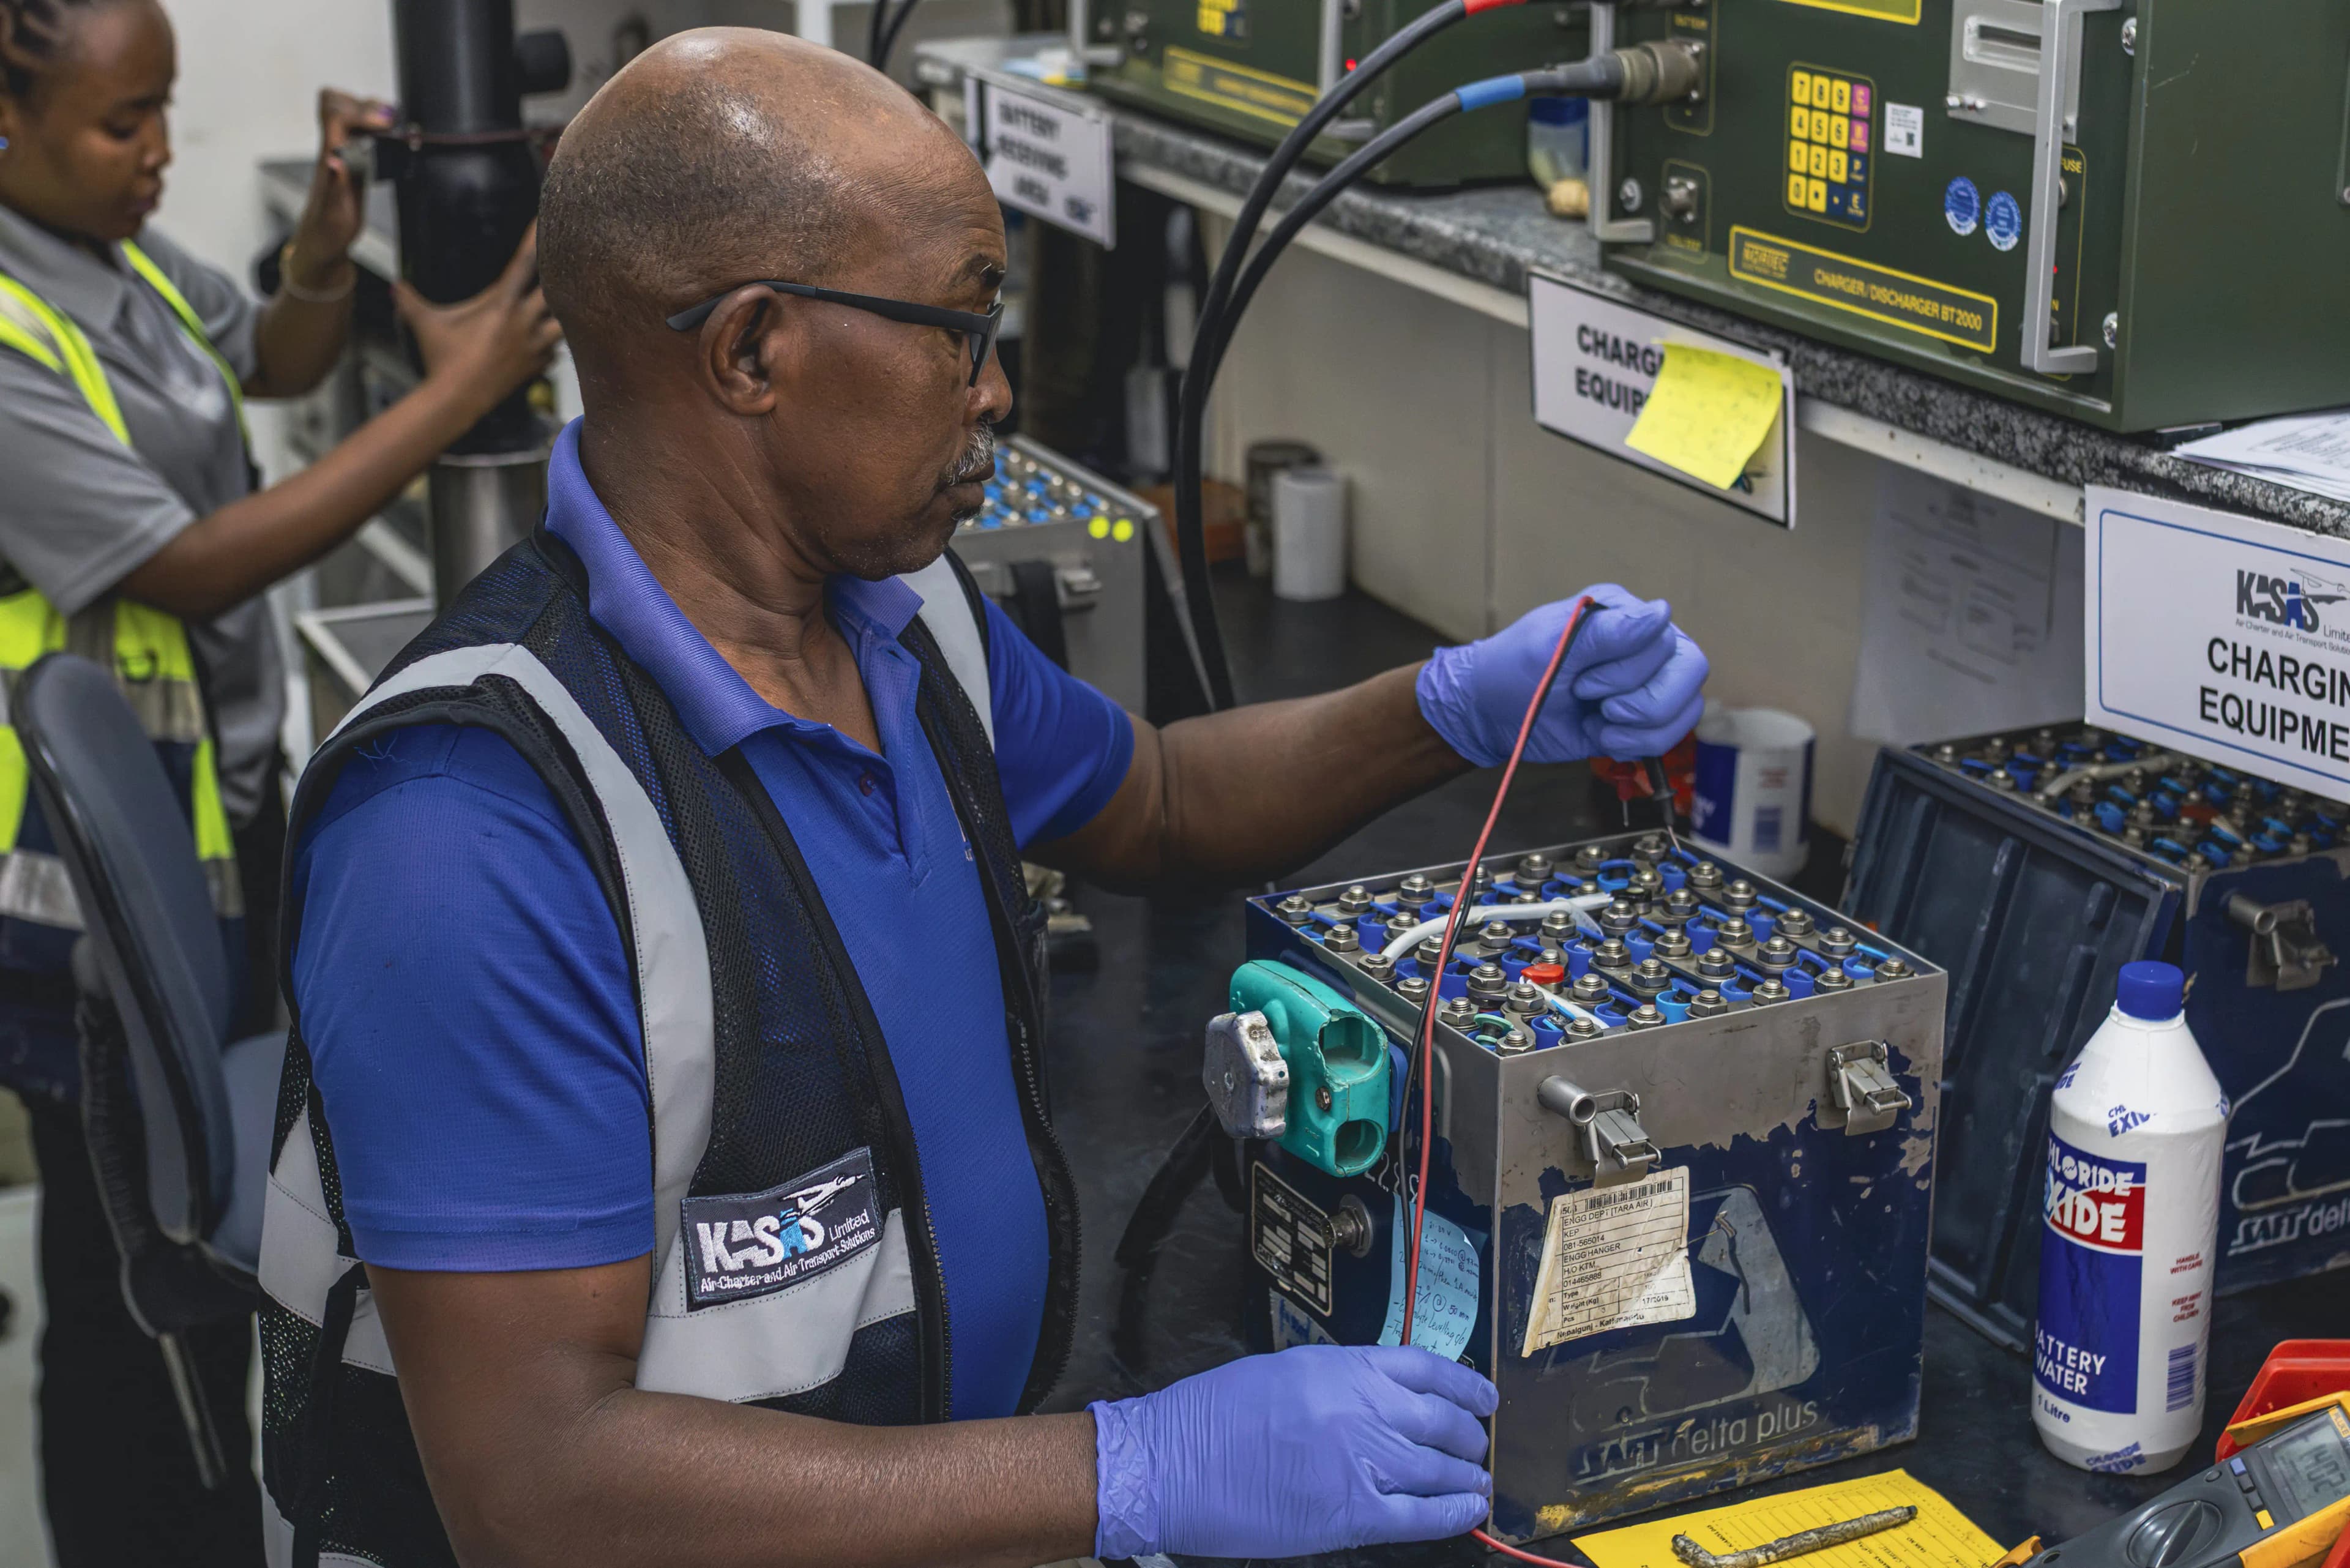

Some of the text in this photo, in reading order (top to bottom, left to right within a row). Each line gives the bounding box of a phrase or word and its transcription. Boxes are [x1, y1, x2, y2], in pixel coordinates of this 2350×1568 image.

[1798, 79, 1805, 98] 7
[1817, 84, 1825, 102] 8
[1837, 89, 1844, 106] 9
[1816, 118, 1824, 136] 5
[1835, 123, 1843, 141] 6
[1815, 153, 1822, 170] 2
[1833, 157, 1841, 175] 3
[1575, 366, 1651, 417] EQUIP
[2237, 569, 2319, 633] KASAS
[2271, 629, 2283, 638] and
[2285, 630, 2294, 641] Air
[2296, 633, 2327, 650] Transport
[2200, 685, 2350, 764] EQUIPME
[1564, 1213, 1587, 1226] ENGG
[1589, 1209, 1608, 1221] DEPT
[1636, 1200, 1649, 1209] AIR
[696, 1208, 870, 1273] KASAS Limited
[1564, 1228, 1579, 1239] KEP
[1564, 1234, 1605, 1251] 081-565014
[784, 1262, 798, 1278] Air
[798, 1250, 839, 1274] Transport
[840, 1227, 876, 1252] Solutions
[1564, 1242, 1621, 1263] ENGG HANGER
[1579, 1261, 1595, 1271] KTM
[2170, 1264, 2187, 1275] WITH
[1564, 1290, 1579, 1299] Type
[1586, 1297, 1599, 1307] (Kg)
[2036, 1348, 2089, 1395] WATER
[1756, 1400, 1819, 1444] plus
[2044, 1399, 2071, 1424] Litre
